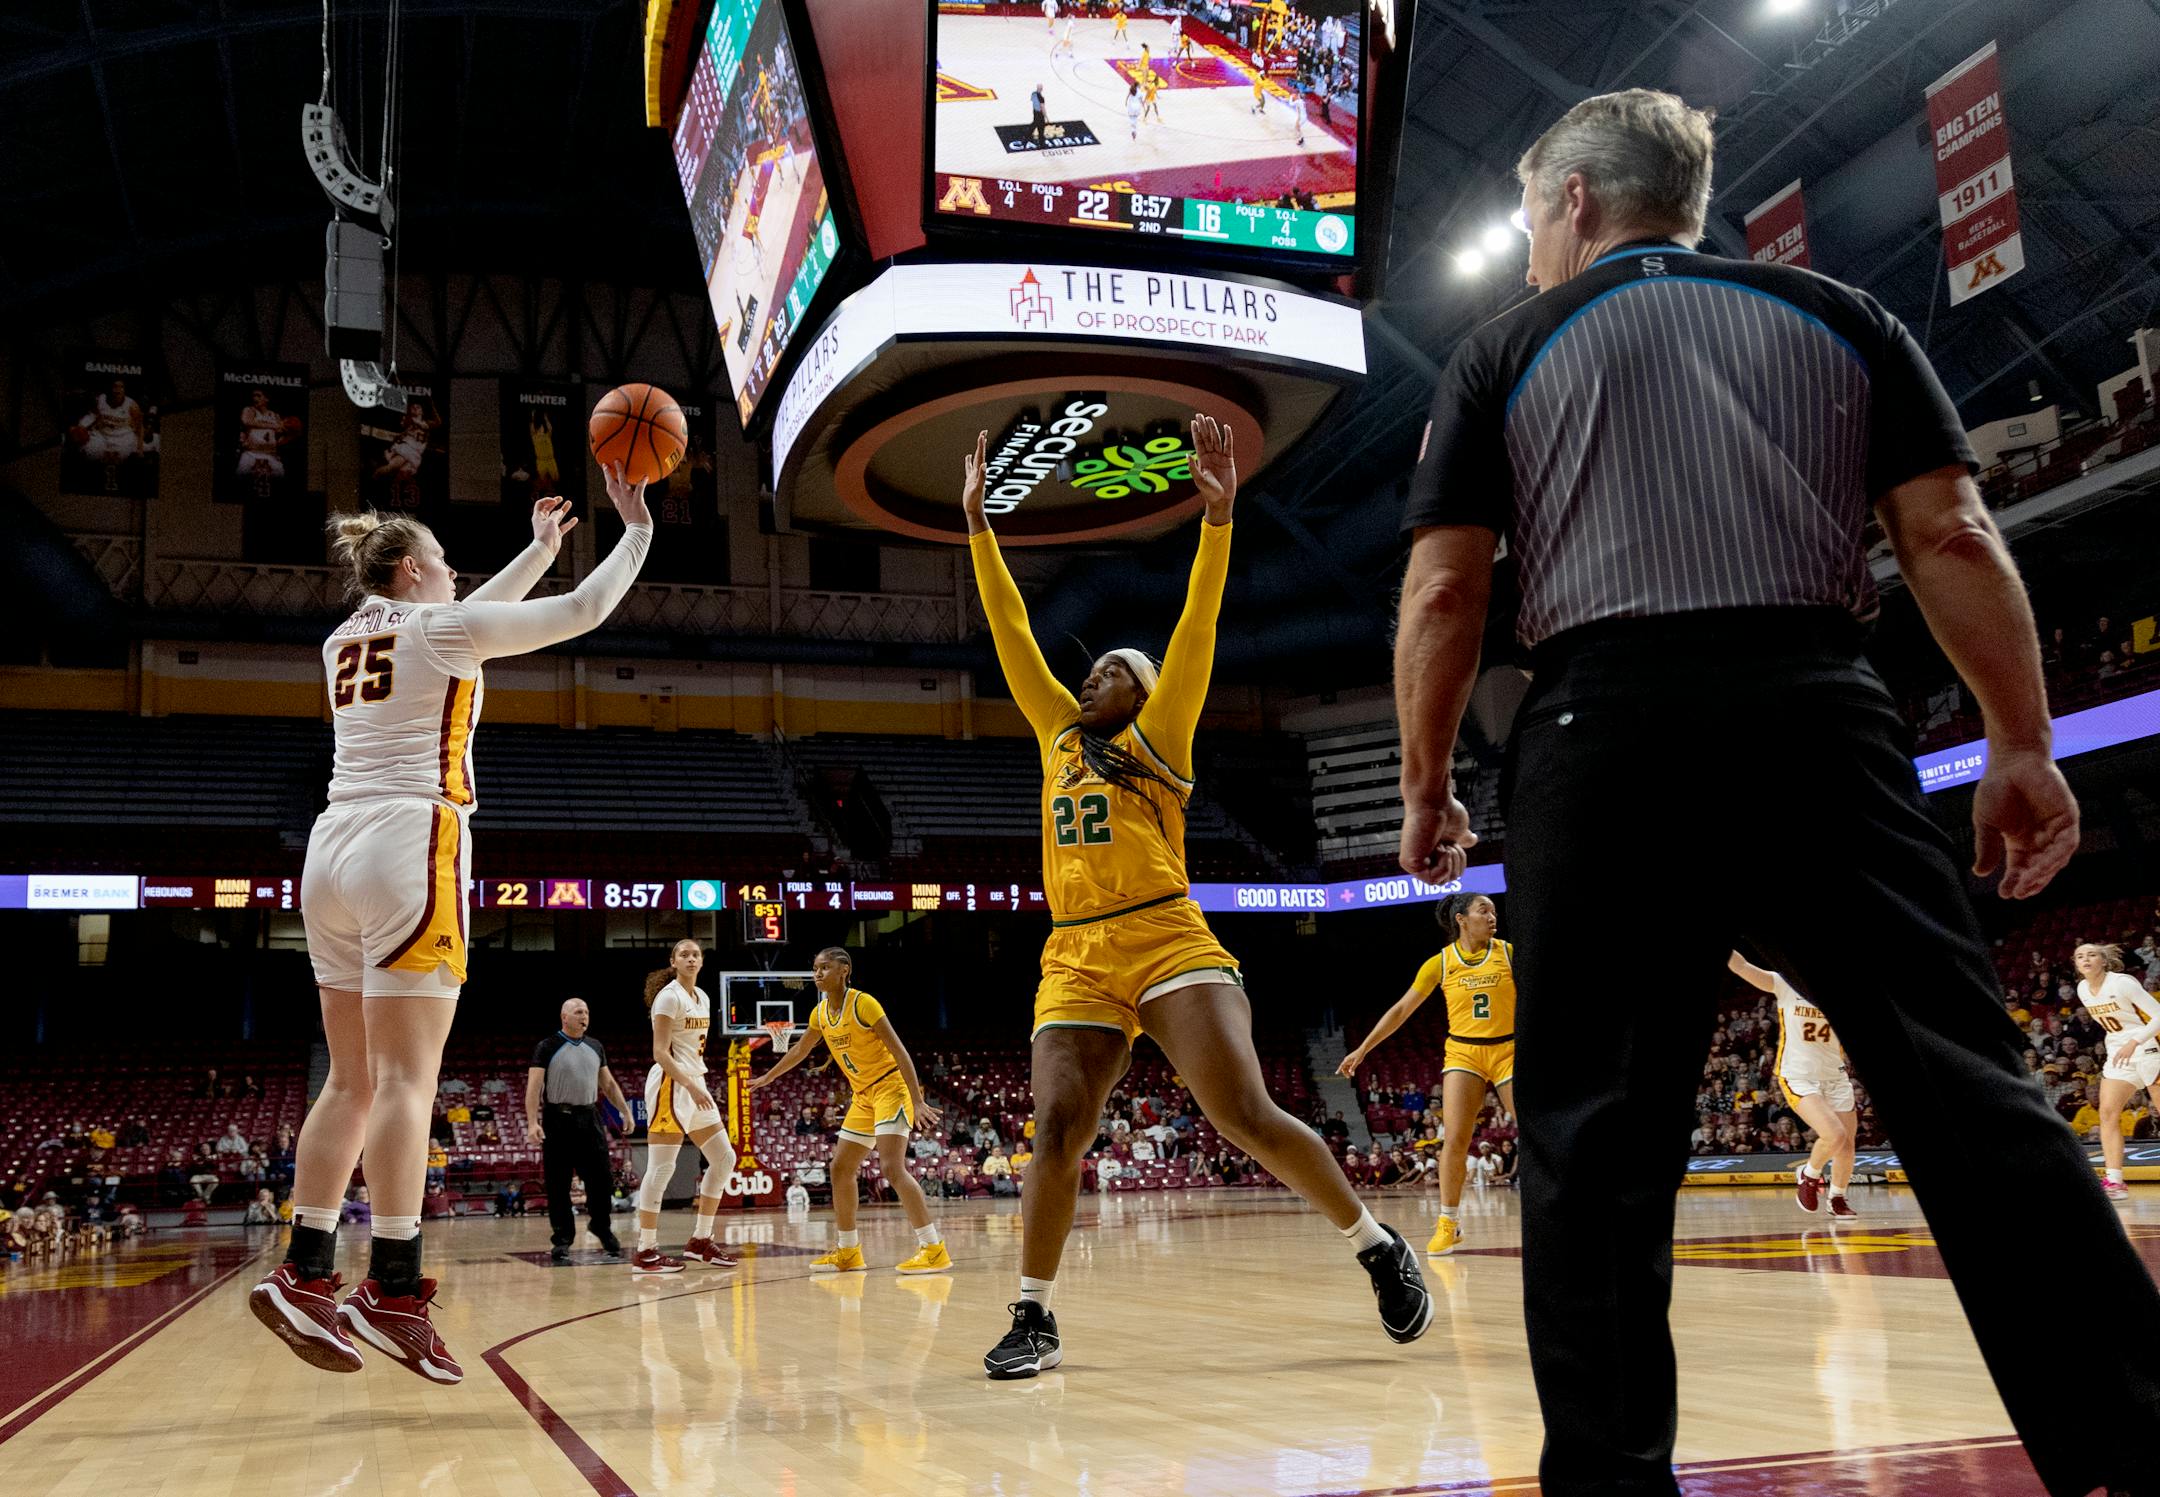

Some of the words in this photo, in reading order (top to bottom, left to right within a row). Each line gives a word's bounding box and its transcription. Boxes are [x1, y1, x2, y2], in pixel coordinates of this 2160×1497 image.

[1936, 115, 1964, 146] BIG
[1965, 91, 1999, 126] TEN
[1937, 112, 2002, 161] CHAMPIONS
[1042, 149, 1075, 157] COURT
[1032, 183, 1063, 197] FOULS
[1952, 171, 1998, 212] 1911
[1004, 192, 1014, 209] 4
[1044, 195, 1053, 213] 0
[1078, 190, 1109, 221] 22
[1131, 195, 1171, 219] 8:57
[1196, 204, 1221, 233] 16
[1236, 206, 1265, 218] FOULS
[1139, 221, 1160, 234] 2ND
[1250, 216, 1255, 233] 1
[1281, 220, 1290, 236] 4
[1272, 236, 1297, 247] POSS
[1754, 242, 1776, 263] BIG
[1776, 223, 1802, 252] TEN
[1062, 271, 1125, 304] THE
[1147, 277, 1278, 322] PILLARS
[1077, 311, 1107, 328] OF
[1113, 313, 1217, 339] PROSPECT
[1222, 324, 1269, 346] PARK
[84, 361, 142, 375] BANHAM
[791, 325, 840, 402] PILLARS
[223, 372, 303, 387] McCARVILLE
[520, 393, 567, 405] HUNTER
[335, 634, 397, 711] 25
[1954, 755, 1982, 771] PLUS
[1052, 792, 1113, 847] 22
[34, 889, 88, 898] BREMER
[94, 889, 129, 898] BANK
[144, 887, 193, 897] REBOUNDS
[215, 879, 250, 893] MINN
[282, 880, 292, 893] 3
[497, 883, 528, 905] 22
[604, 883, 664, 908] 8:57
[738, 885, 766, 900] 16
[787, 882, 812, 892] FOULS
[854, 890, 893, 900] REBOUNDS
[912, 884, 941, 897] MINN
[967, 884, 975, 896] 3
[1010, 884, 1019, 896] 8
[1237, 888, 1277, 907] GOOD
[1280, 888, 1326, 907] RATES
[1364, 882, 1409, 902] GOOD
[215, 894, 249, 908] NORF
[282, 894, 292, 908] 2
[755, 903, 782, 917] 8:57
[796, 894, 806, 909] 1
[829, 894, 841, 909] 4
[912, 897, 940, 910] NORF
[967, 898, 976, 911] 2
[1011, 898, 1019, 911] 7
[766, 916, 779, 938] 5
[1472, 992, 1490, 1018] 2
[1803, 1022, 1831, 1043] 24
[2098, 1016, 2123, 1034] 10
[842, 1052, 859, 1074] 4
[739, 1069, 752, 1153] MINNESOTA
[723, 1170, 773, 1196] Cub
